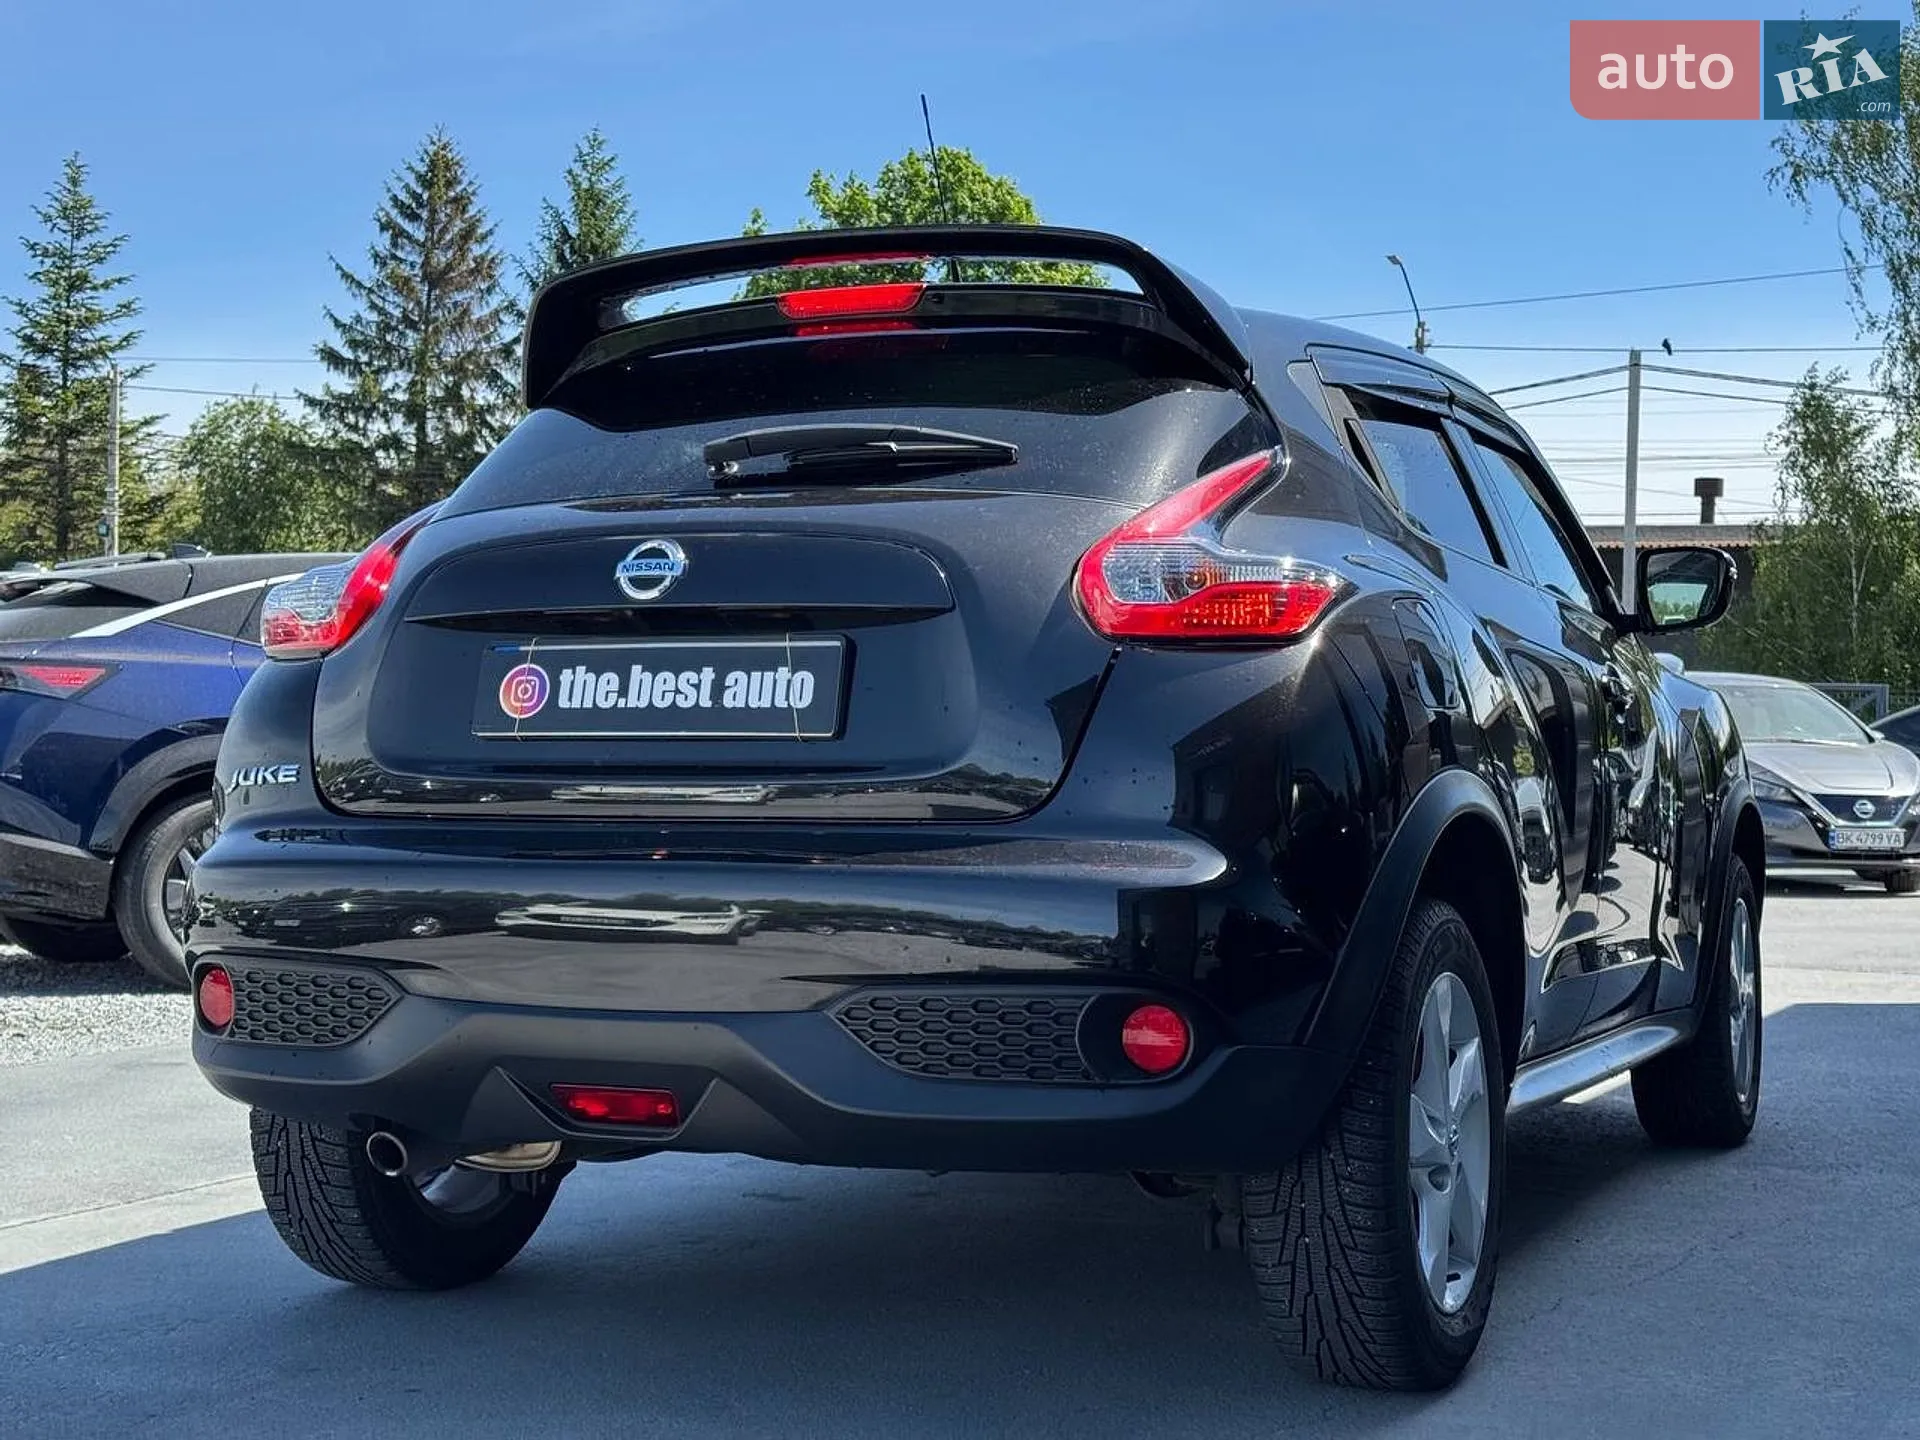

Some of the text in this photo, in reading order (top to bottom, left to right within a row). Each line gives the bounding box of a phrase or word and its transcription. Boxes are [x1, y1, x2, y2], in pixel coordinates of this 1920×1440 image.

[621, 561, 675, 573] NISSAN
[558, 665, 815, 708] the.best auto
[226, 765, 300, 796] JUKE
[1856, 832, 1883, 844] 4799
